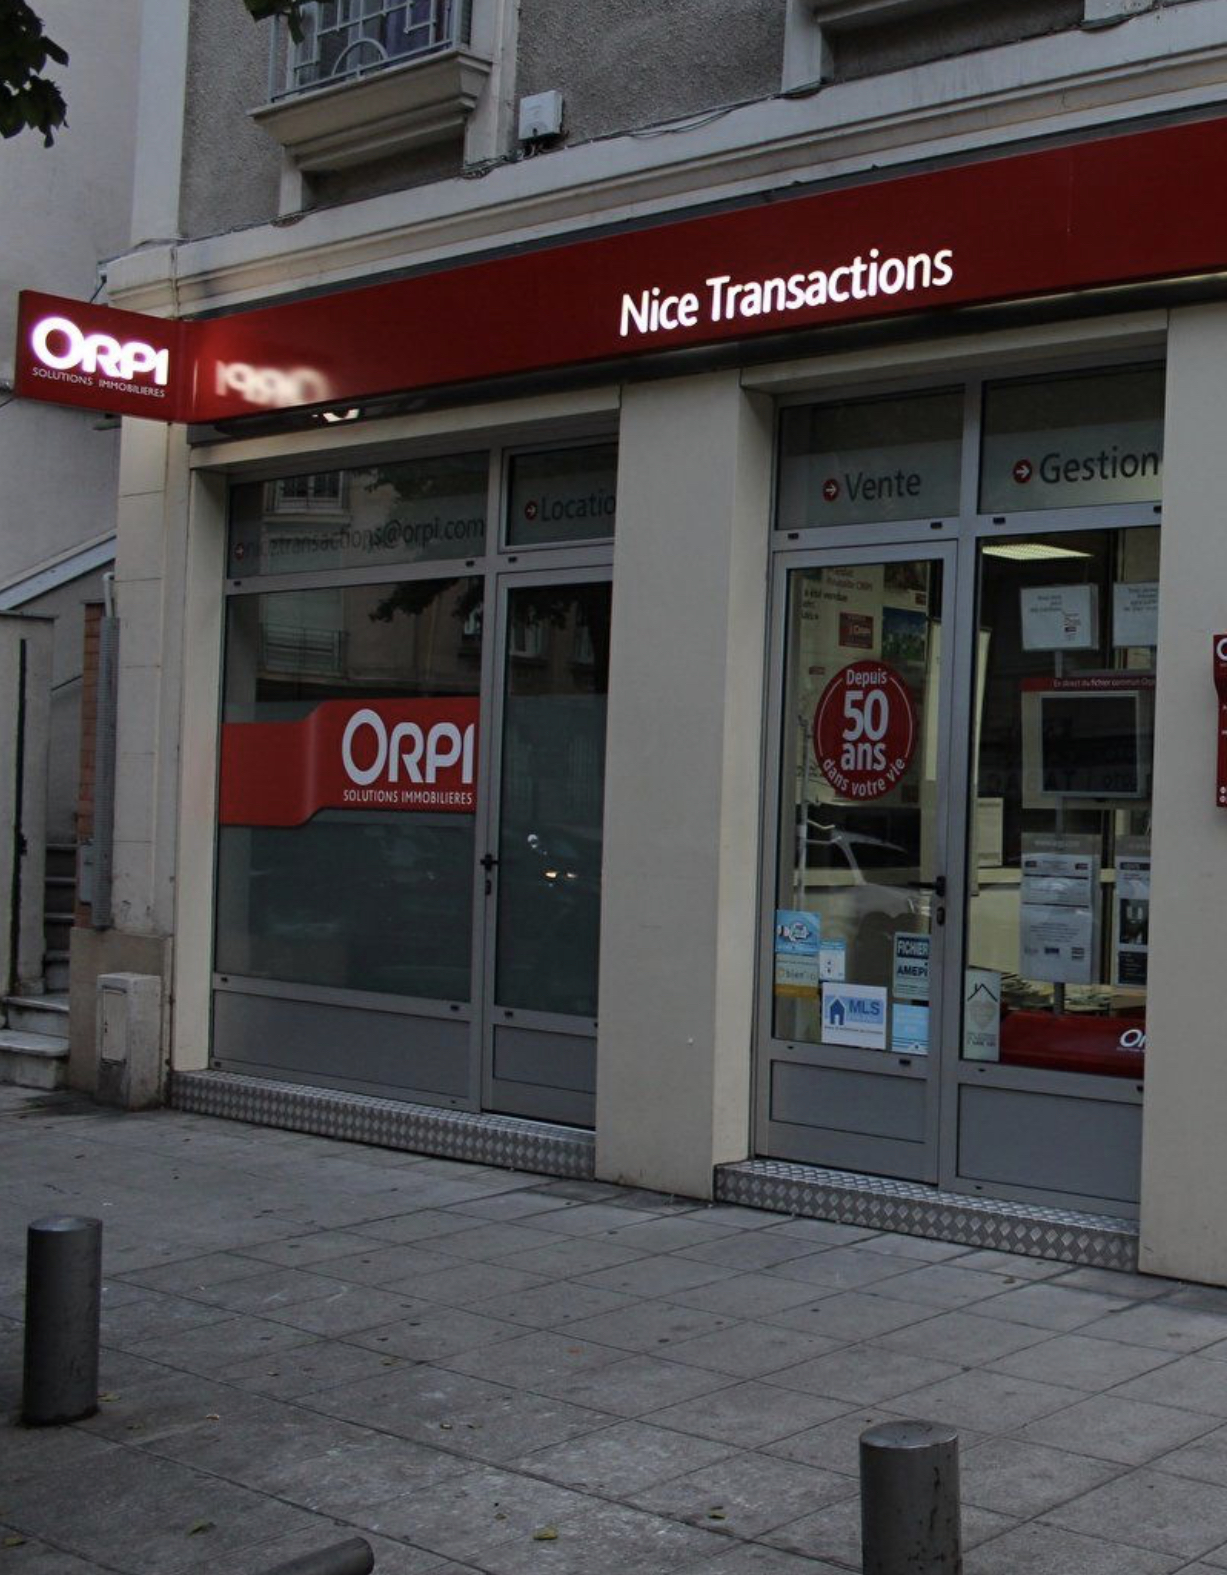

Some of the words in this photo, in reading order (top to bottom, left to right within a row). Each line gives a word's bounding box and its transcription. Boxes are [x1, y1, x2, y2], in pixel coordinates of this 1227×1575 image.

[619, 287, 699, 337] Nice
[705, 248, 954, 322] Transactions
[32, 316, 169, 386] ORPI
[32, 366, 93, 387] SOLUTIONS
[98, 378, 166, 398] IMMOBILIERES
[1040, 446, 1159, 485] Gestion
[844, 470, 922, 502] Vente
[846, 668, 887, 687] Depuis
[842, 689, 889, 741] 50
[341, 708, 475, 786] ORPI
[841, 742, 887, 771] ans
[823, 758, 849, 791] dans
[851, 779, 886, 797] votre
[886, 758, 905, 782] vie
[343, 789, 398, 803] SOLUTIONS
[401, 790, 473, 805] IMMOBILIERES
[849, 1000, 880, 1016] MLS
